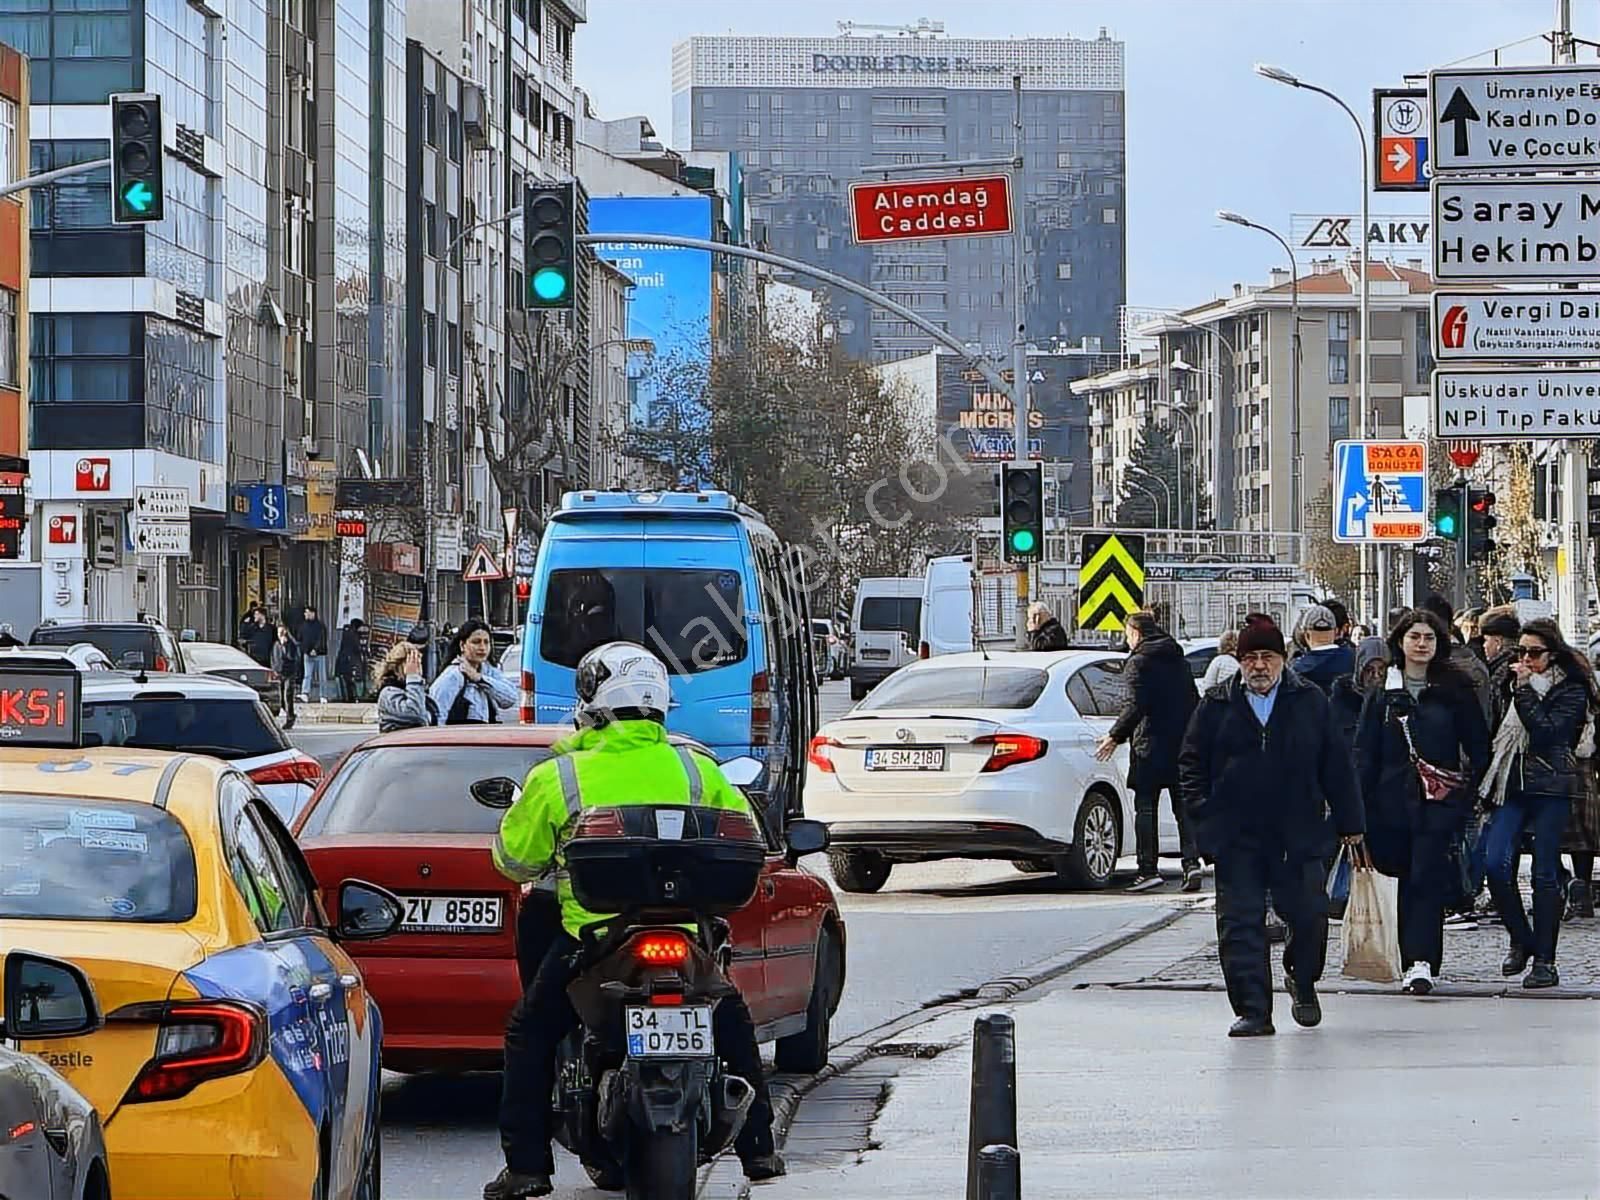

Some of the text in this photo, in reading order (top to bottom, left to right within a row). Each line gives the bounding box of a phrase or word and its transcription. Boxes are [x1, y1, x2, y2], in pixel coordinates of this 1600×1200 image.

[1487, 110, 1557, 128] Kadın
[1488, 137, 1596, 159] Ve Çocuk
[874, 187, 988, 210] Alemdağ
[880, 211, 984, 232] Caddesi
[1443, 196, 1563, 229] Saray
[1442, 235, 1597, 263] Hekimb
[1483, 301, 1551, 322] Vergi
[959, 411, 1044, 429] MiGRS
[1445, 405, 1486, 427] NPİ
[1497, 410, 1533, 431] Tıp
[1400, 524, 1421, 535] VER
[873, 750, 941, 765] 34 SM 2180
[406, 899, 497, 924] ZV 8585
[632, 1011, 707, 1029] 34 TL
[649, 1032, 704, 1050] 0756
